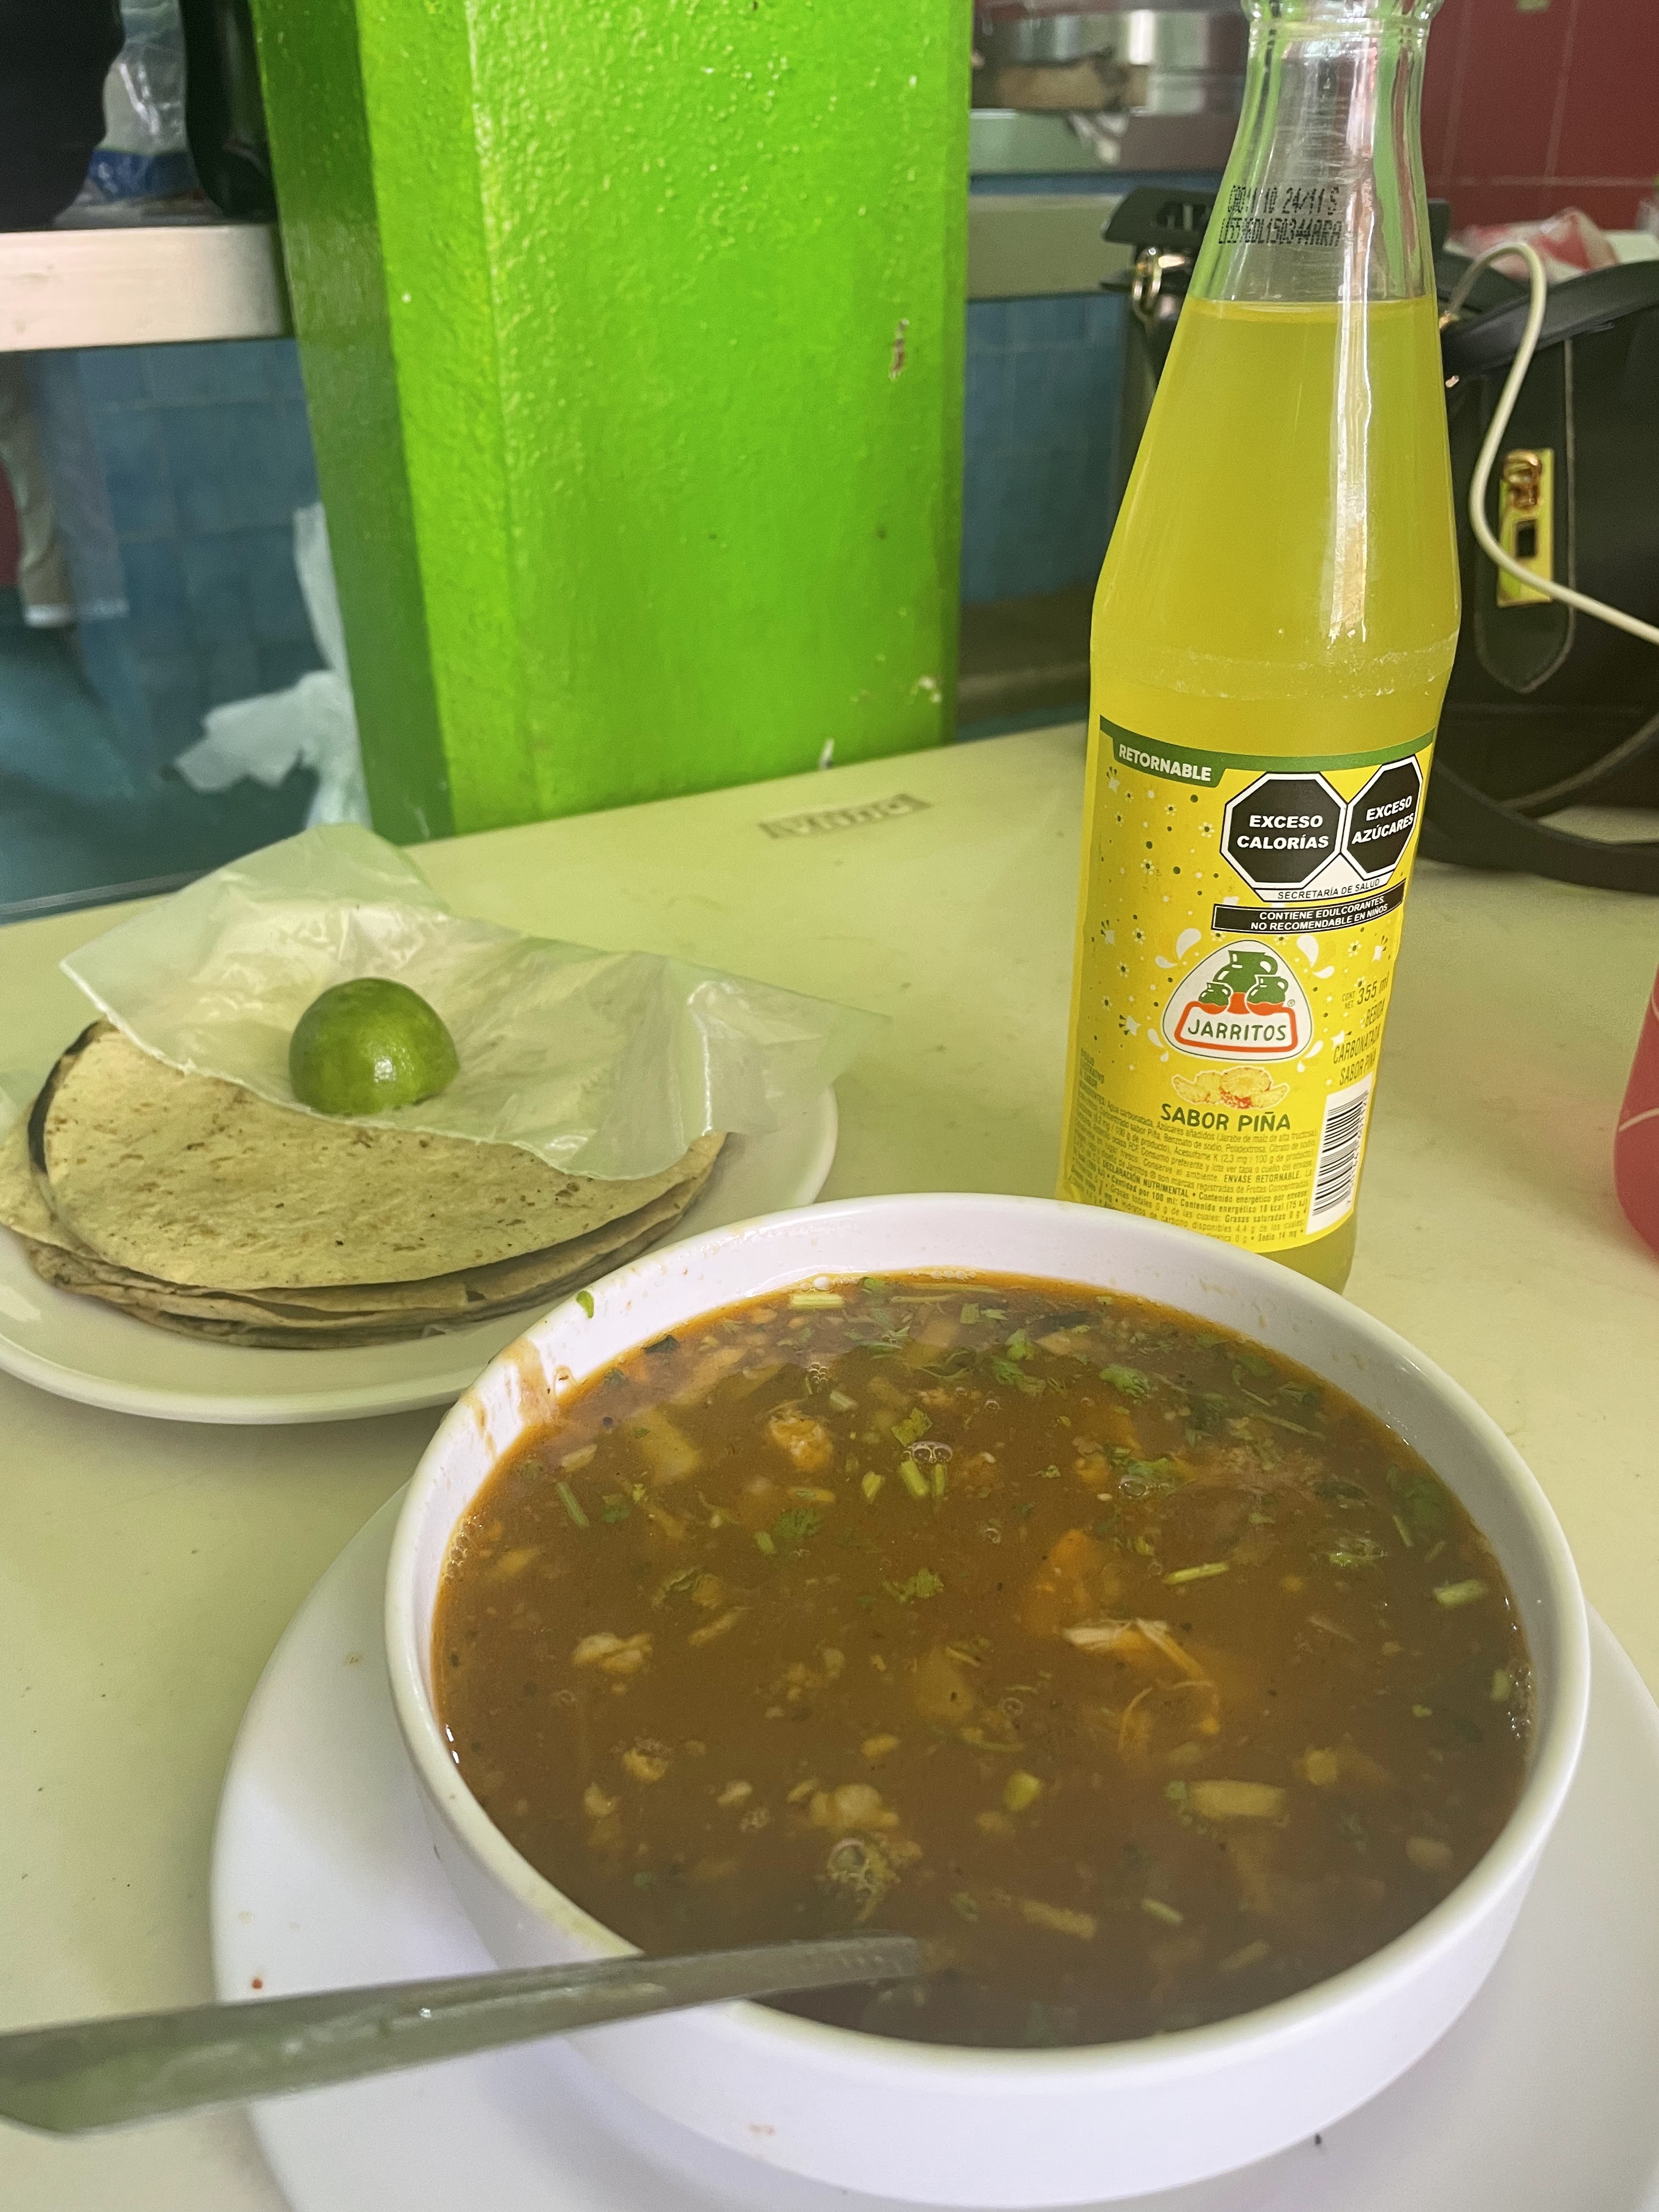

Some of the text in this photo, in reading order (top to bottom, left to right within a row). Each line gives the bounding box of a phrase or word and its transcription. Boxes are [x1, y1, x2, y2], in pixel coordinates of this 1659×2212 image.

[1119, 743, 1212, 782] RETORNABLE
[1365, 795, 1413, 822] EXCESO
[1249, 815, 1323, 828] EXCESO
[1351, 812, 1414, 845] AZÚCARES
[1237, 834, 1329, 850] CALORÍAS
[1277, 878, 1380, 900] SECRETARÍA DE SALUD
[1250, 903, 1389, 931] NO RECOMENDABLE EN NIÑOS
[1259, 911, 1314, 921] CONTIENE
[1357, 980, 1378, 1006] 355
[1188, 1019, 1286, 1041] JARRITOS
[1339, 1058, 1365, 1086] SABOR
[1160, 1103, 1291, 1132] SABOR PIÑA
[1156, 1121, 1184, 1136] Azúcares
[1185, 1128, 1215, 1141] añadidos
[1243, 1135, 1251, 1143] de
[1269, 1134, 1278, 1143] de
[1164, 1133, 1193, 1148] Benzoato
[1193, 1140, 1202, 1149] de
[1290, 1142, 1299, 1151] de
[1213, 1153, 1219, 1163] K
[1236, 1155, 1248, 1165] mg
[1255, 1154, 1268, 1164] 100
[1268, 1155, 1274, 1165] g
[1276, 1154, 1284, 1163] de
[1197, 1183, 1234, 1193] registradas
[1235, 1184, 1244, 1194] de
[1223, 1174, 1252, 1183] ENVASE
[1143, 1178, 1189, 1198] NUTRIMENTAL
[1199, 1191, 1233, 1203] Contenido
[1235, 1195, 1272, 1205] energético
[1273, 1194, 1285, 1204] por
[1152, 1192, 1164, 1201] 100
[1180, 1198, 1216, 1212] Contenido
[1218, 1206, 1256, 1215] energético
[1260, 1204, 1268, 1213] 18
[1270, 1202, 1284, 1212] kcal
[1224, 1214, 1250, 1223] Grasas
[1253, 1214, 1286, 1223] saturadas
[1257, 1233, 1275, 1242] Sodio
